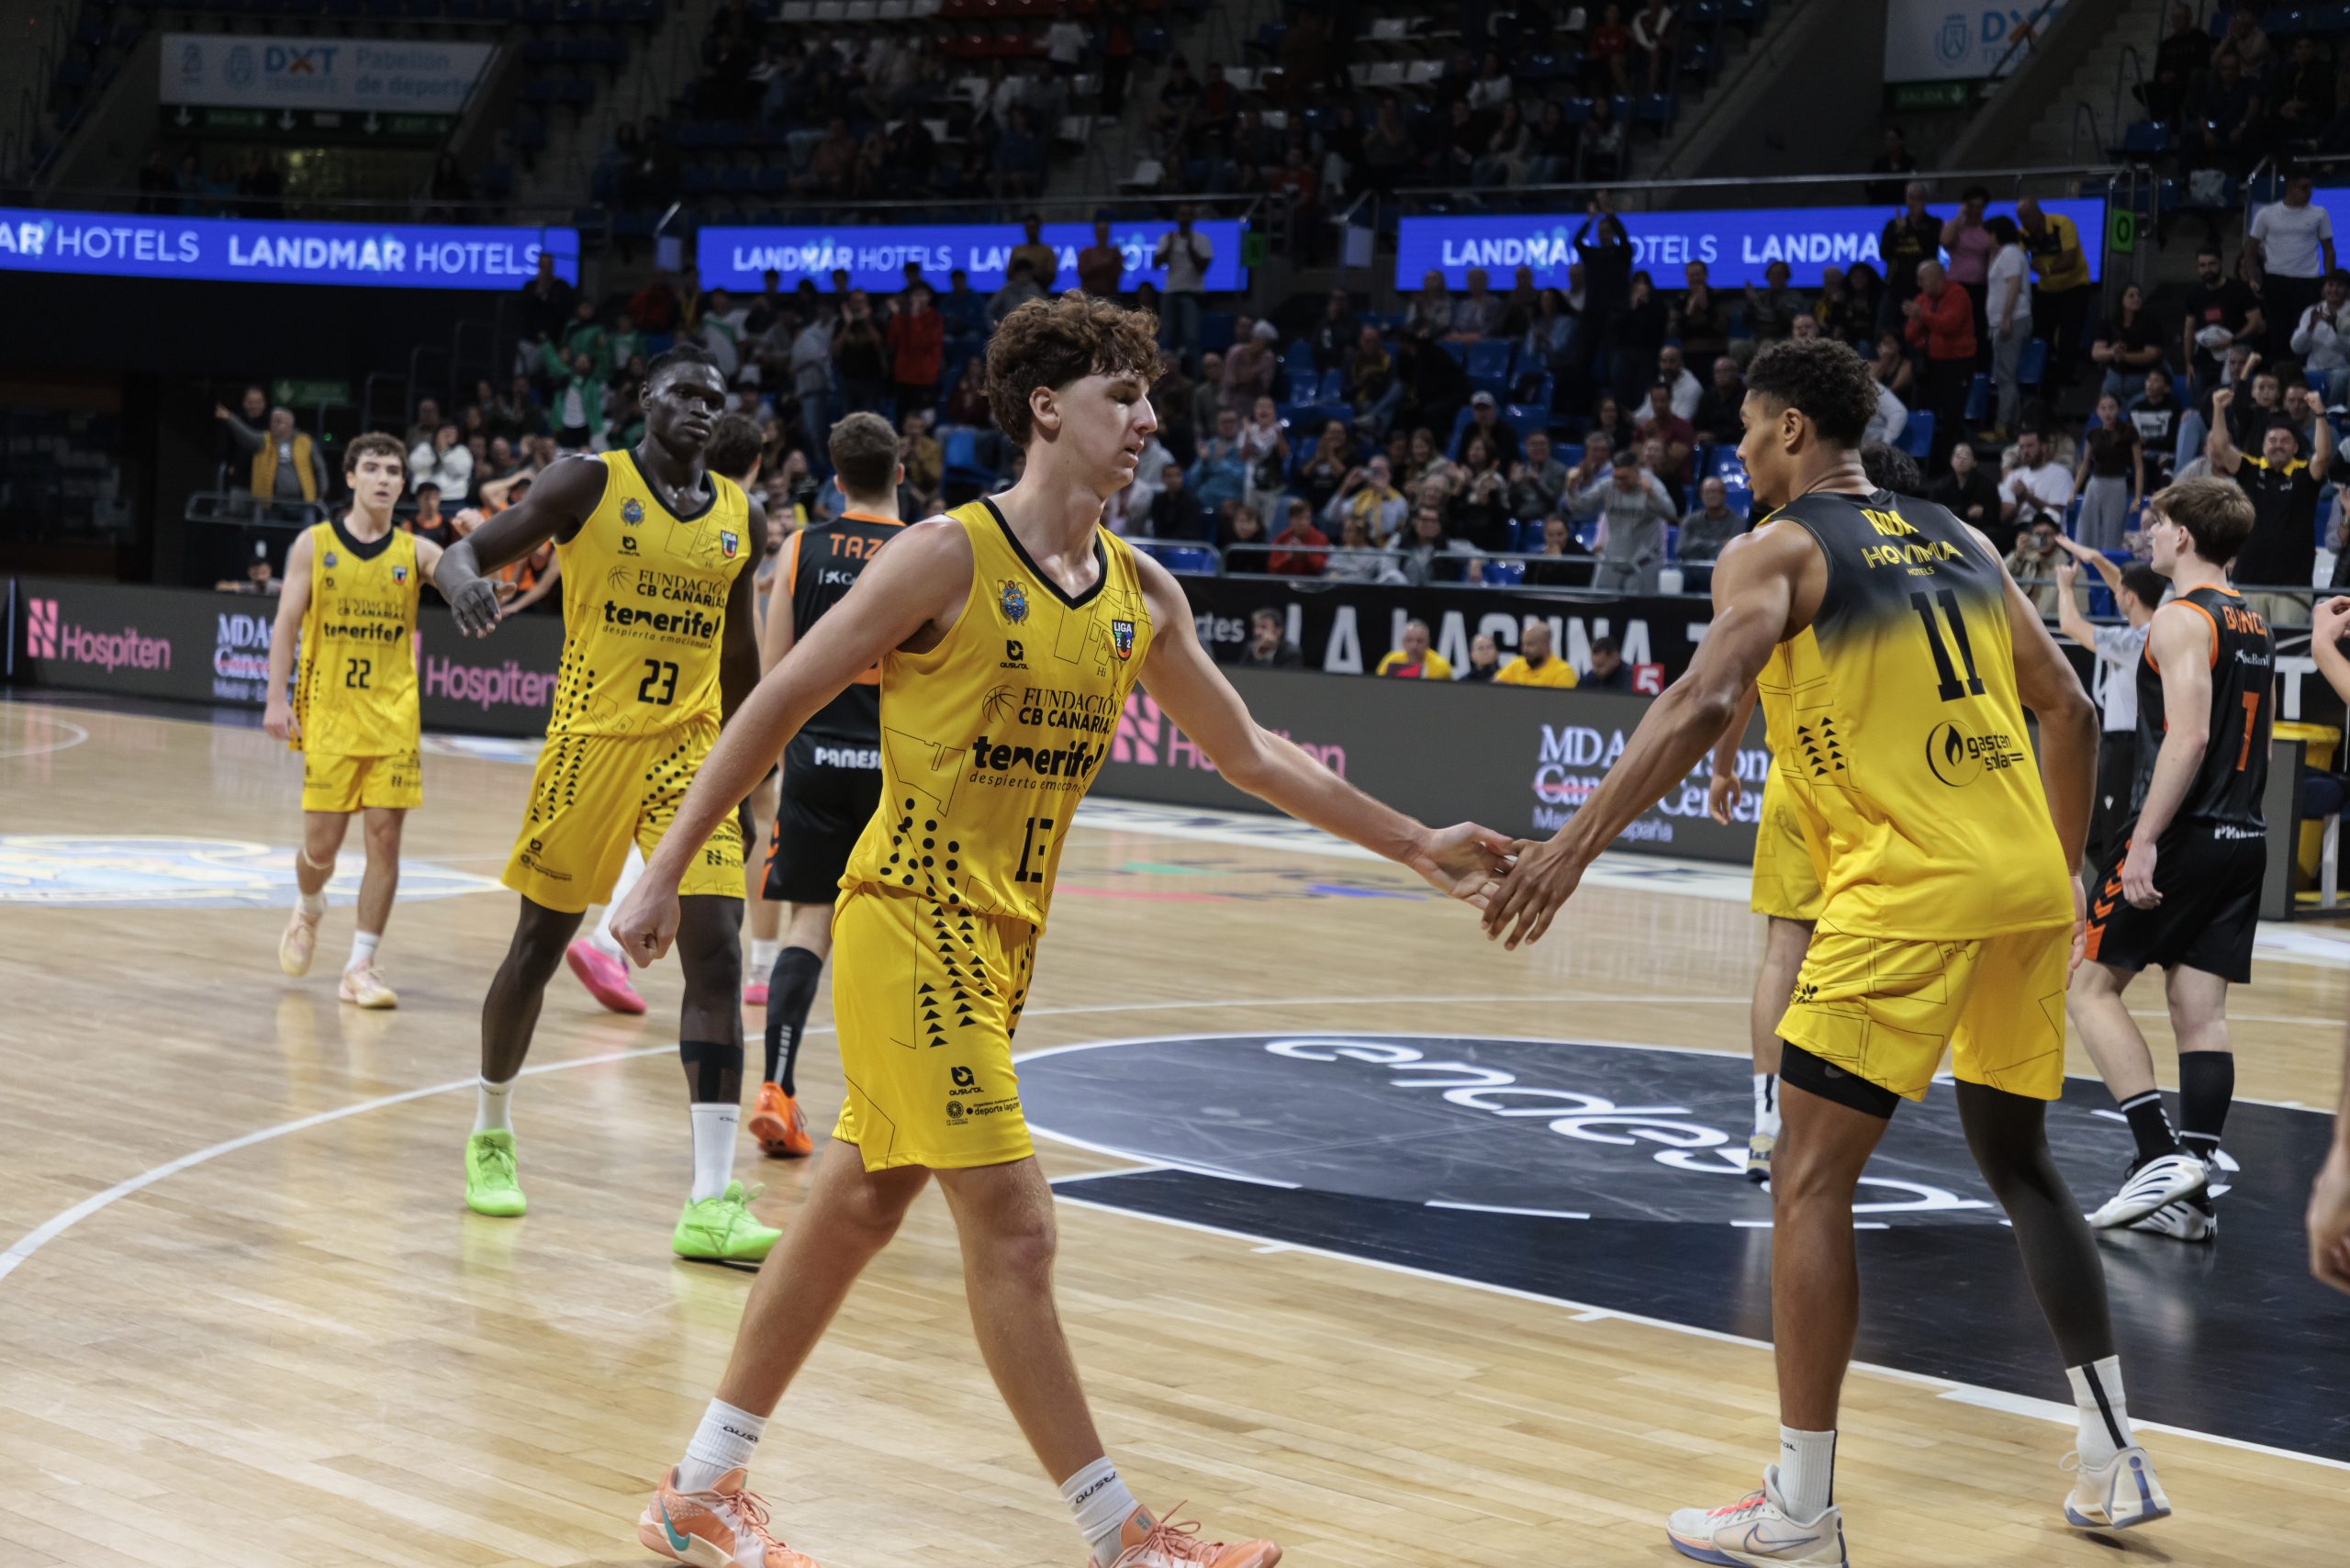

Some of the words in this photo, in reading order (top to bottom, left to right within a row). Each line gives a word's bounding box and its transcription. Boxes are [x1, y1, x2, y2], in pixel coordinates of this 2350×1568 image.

[263, 46, 339, 74] DXT
[56, 225, 201, 263] HOTELS
[229, 234, 408, 274] LANDMAR
[416, 241, 543, 276] HOTELS
[733, 244, 855, 273] LANDMAR
[857, 244, 954, 273] HOTELS
[1442, 237, 1591, 267] LANDMA
[1615, 234, 1719, 264] OTELS
[1861, 540, 1964, 569] HOVIMA
[1907, 566, 1936, 577] HOTELS
[636, 583, 657, 597] CB
[1113, 622, 1133, 633] LIGA
[61, 624, 173, 674] Hospiten
[1909, 588, 1986, 703] 11
[345, 657, 372, 689] 22
[425, 653, 559, 712] Hospiten
[638, 658, 680, 706] 23
[1018, 707, 1044, 726] CB
[2235, 689, 2261, 772] 1
[969, 771, 1037, 791] despierta
[974, 1104, 1003, 1116] deporte
